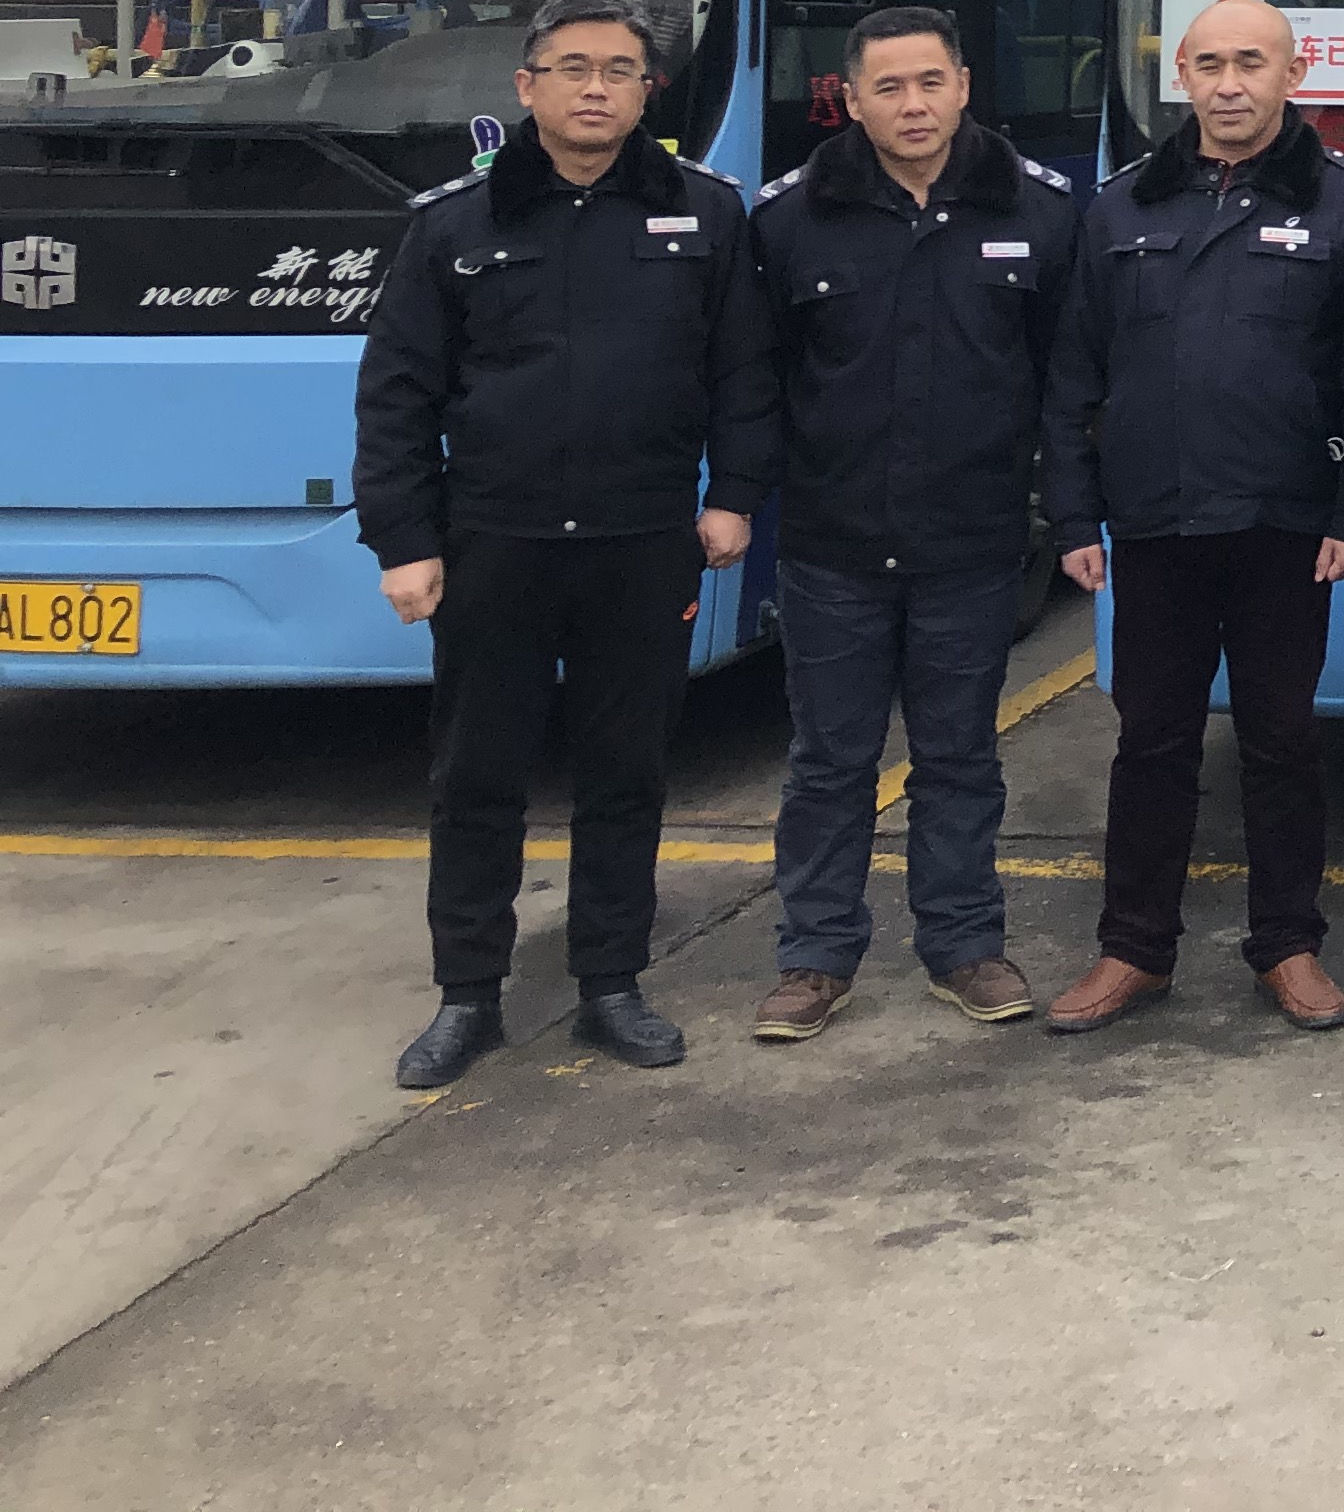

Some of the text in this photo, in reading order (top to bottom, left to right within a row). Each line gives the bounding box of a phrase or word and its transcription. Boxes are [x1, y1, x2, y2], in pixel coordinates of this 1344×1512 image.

[257, 246, 382, 285] 新能
[139, 286, 239, 306] new
[0, 593, 133, 643] AL802
